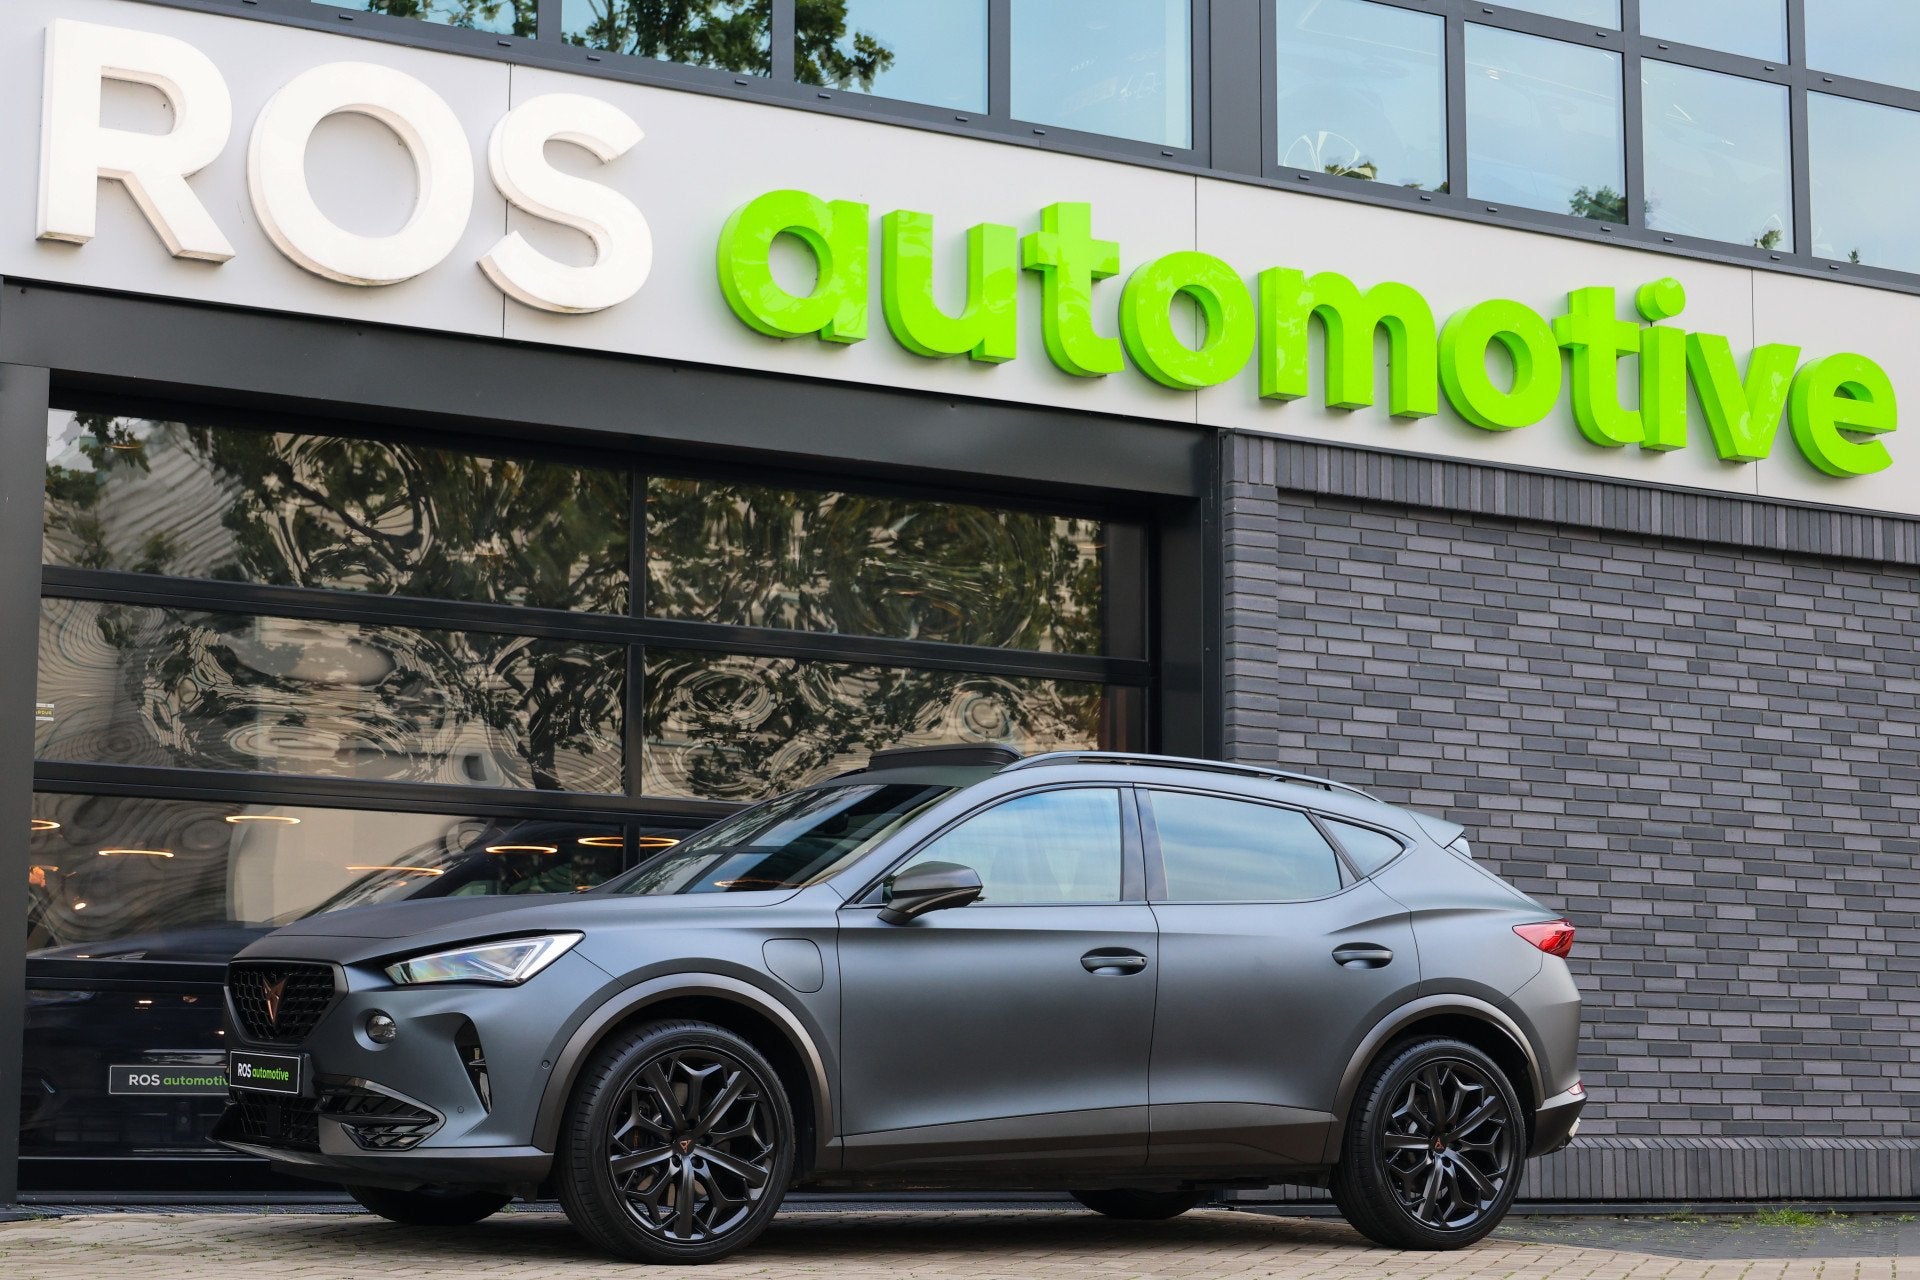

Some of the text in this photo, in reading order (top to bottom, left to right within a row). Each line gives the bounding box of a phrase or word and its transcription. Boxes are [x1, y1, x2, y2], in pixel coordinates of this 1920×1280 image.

[36, 18, 1898, 478] ROS automotive
[129, 1074, 229, 1086] ROS automotiv
[237, 1063, 289, 1081] ROS automotive
